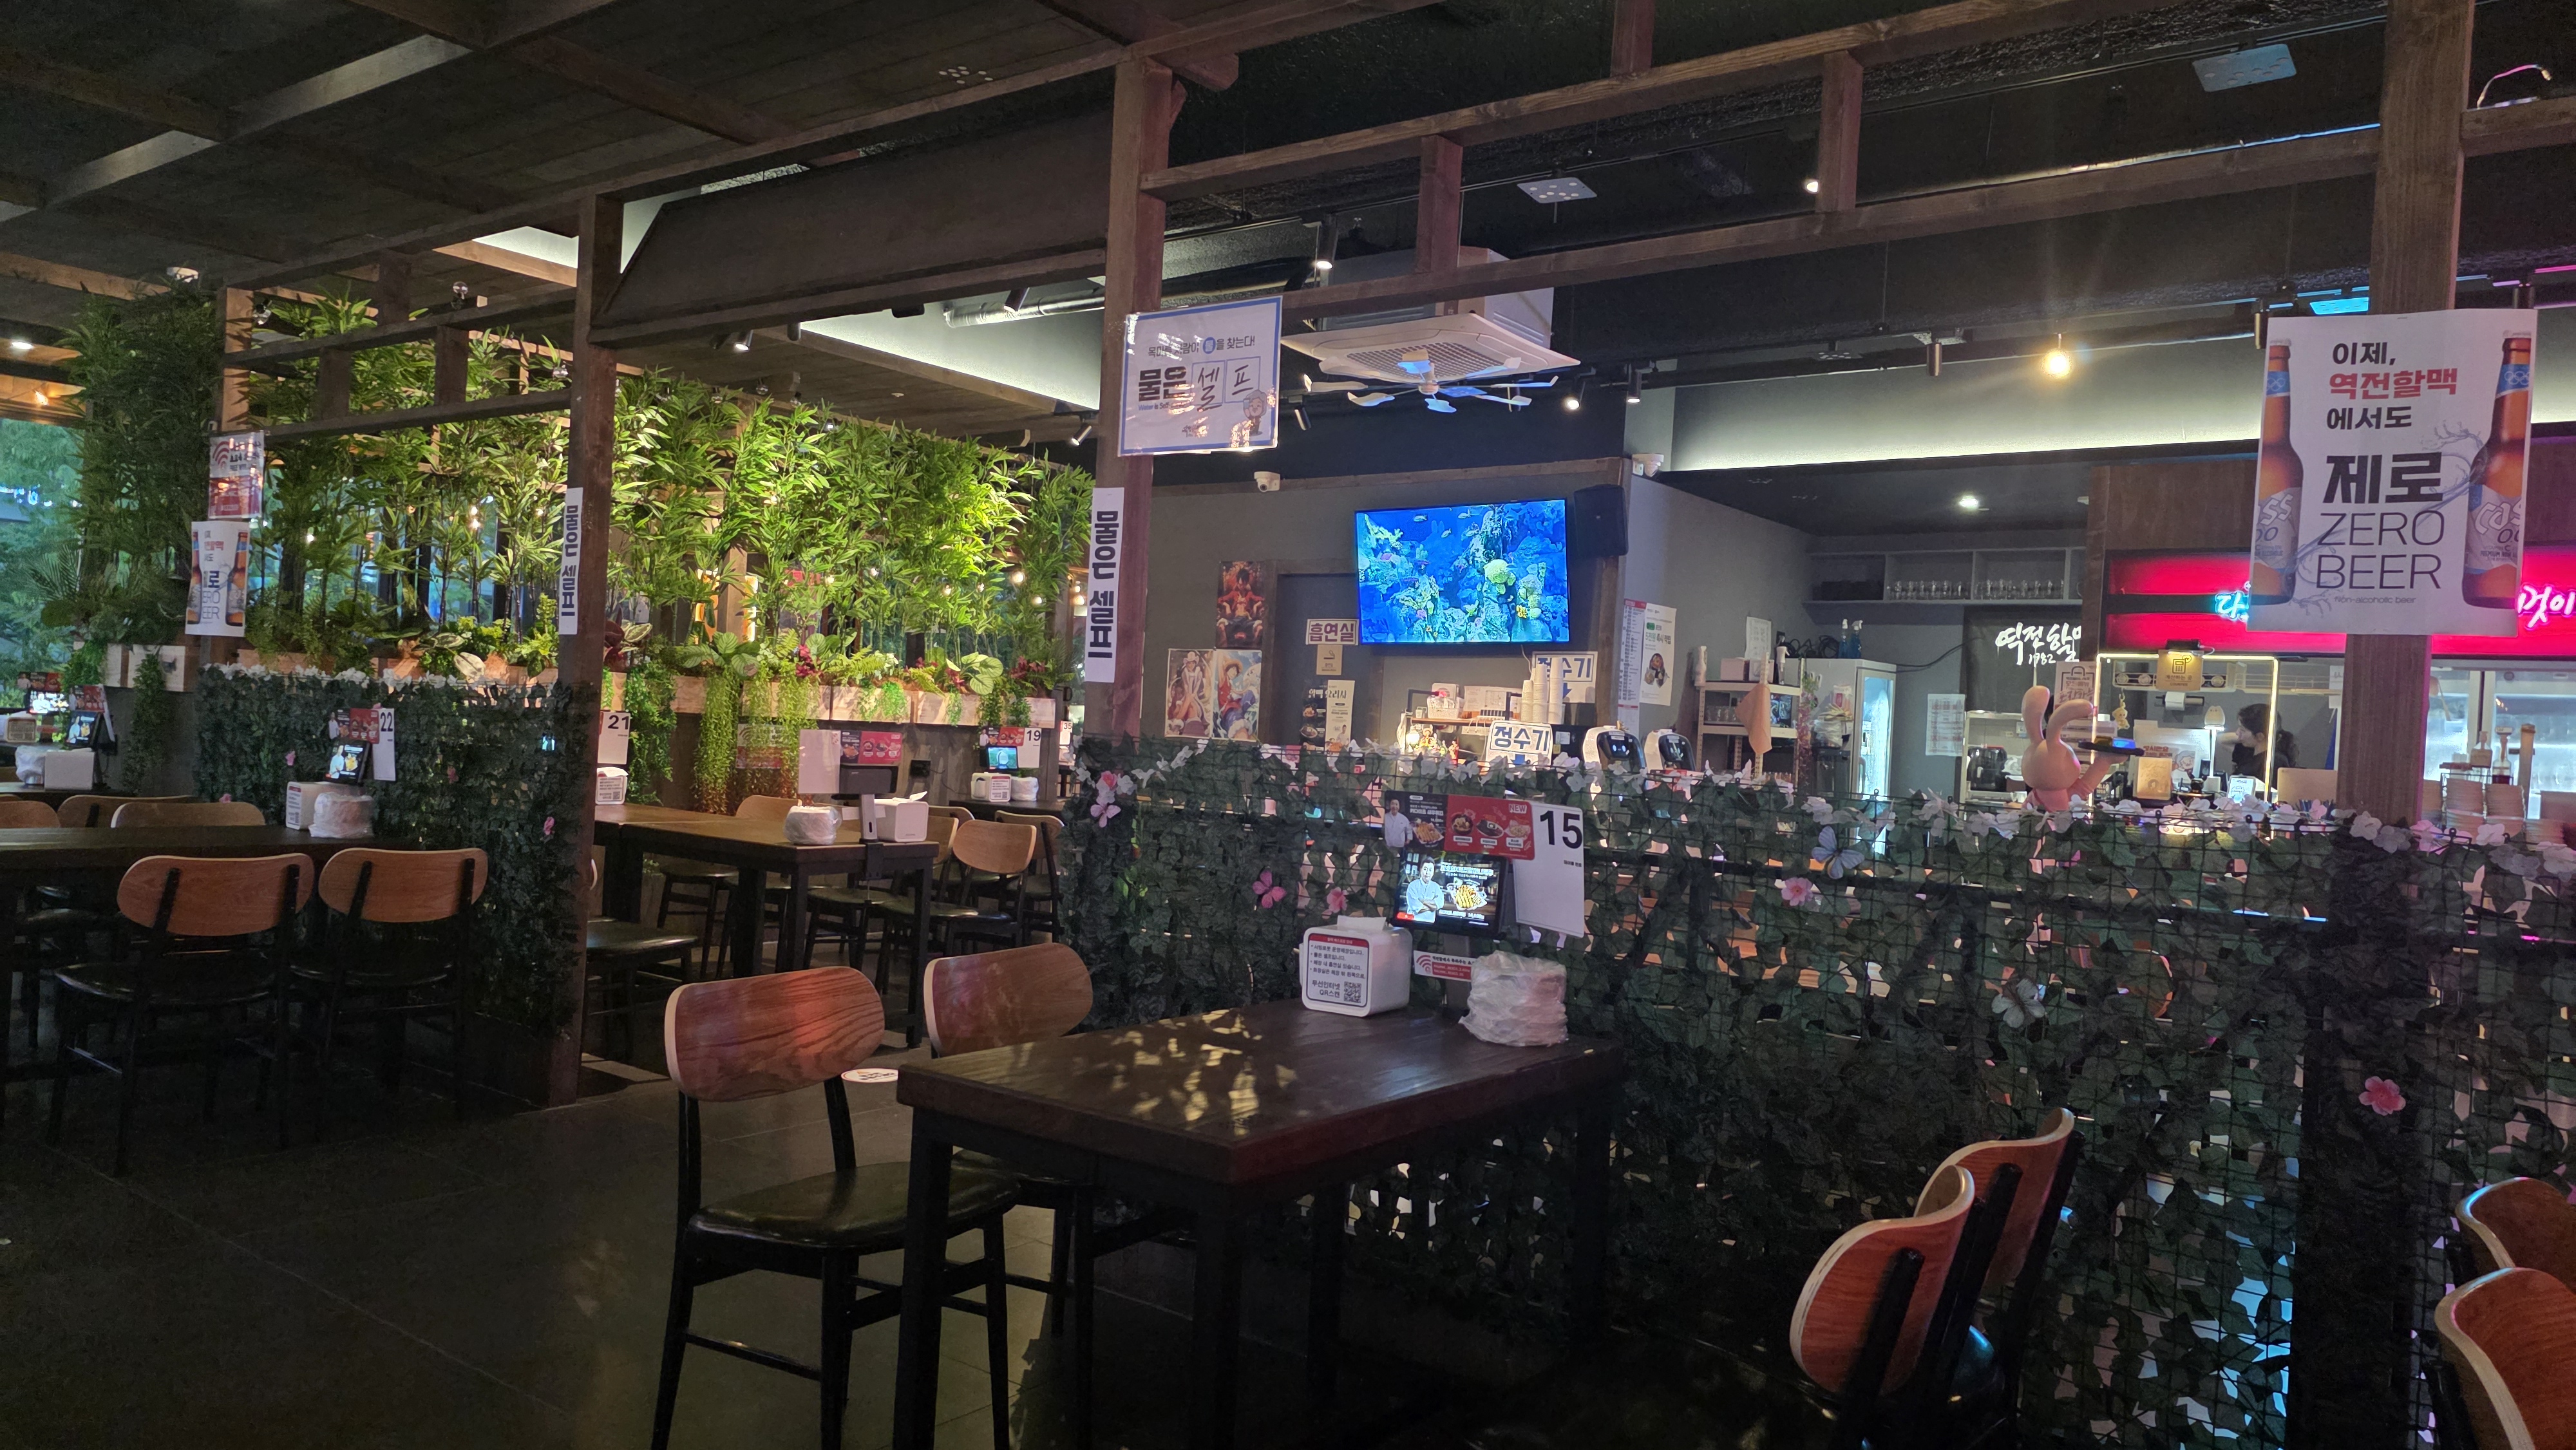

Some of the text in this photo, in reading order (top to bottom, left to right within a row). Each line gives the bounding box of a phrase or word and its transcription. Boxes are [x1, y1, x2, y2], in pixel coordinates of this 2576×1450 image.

[1227, 335, 1255, 349] 찾는다!
[2333, 342, 2396, 365] 이제,
[1139, 364, 1254, 412] 물은 셀프
[2329, 368, 2458, 400] 역전할맥
[2327, 406, 2412, 430] 에서도
[2323, 451, 2443, 504] 제로
[2318, 510, 2445, 547] ZERO
[562, 505, 578, 616] 물은 셀프
[2316, 554, 2441, 589] BEER
[1088, 511, 1119, 658] 물은 셀프
[1309, 622, 1354, 643] 흡연실
[2029, 652, 2056, 667] 1982
[380, 712, 393, 731] 22
[608, 715, 629, 730] 21
[1027, 730, 1041, 741] 19
[1494, 726, 1549, 751] 정수기
[1509, 804, 1527, 813] NEW
[1540, 811, 1582, 849] 15
[1312, 979, 1340, 990] 무선인터넷
[1320, 989, 1340, 998] QR스캔
